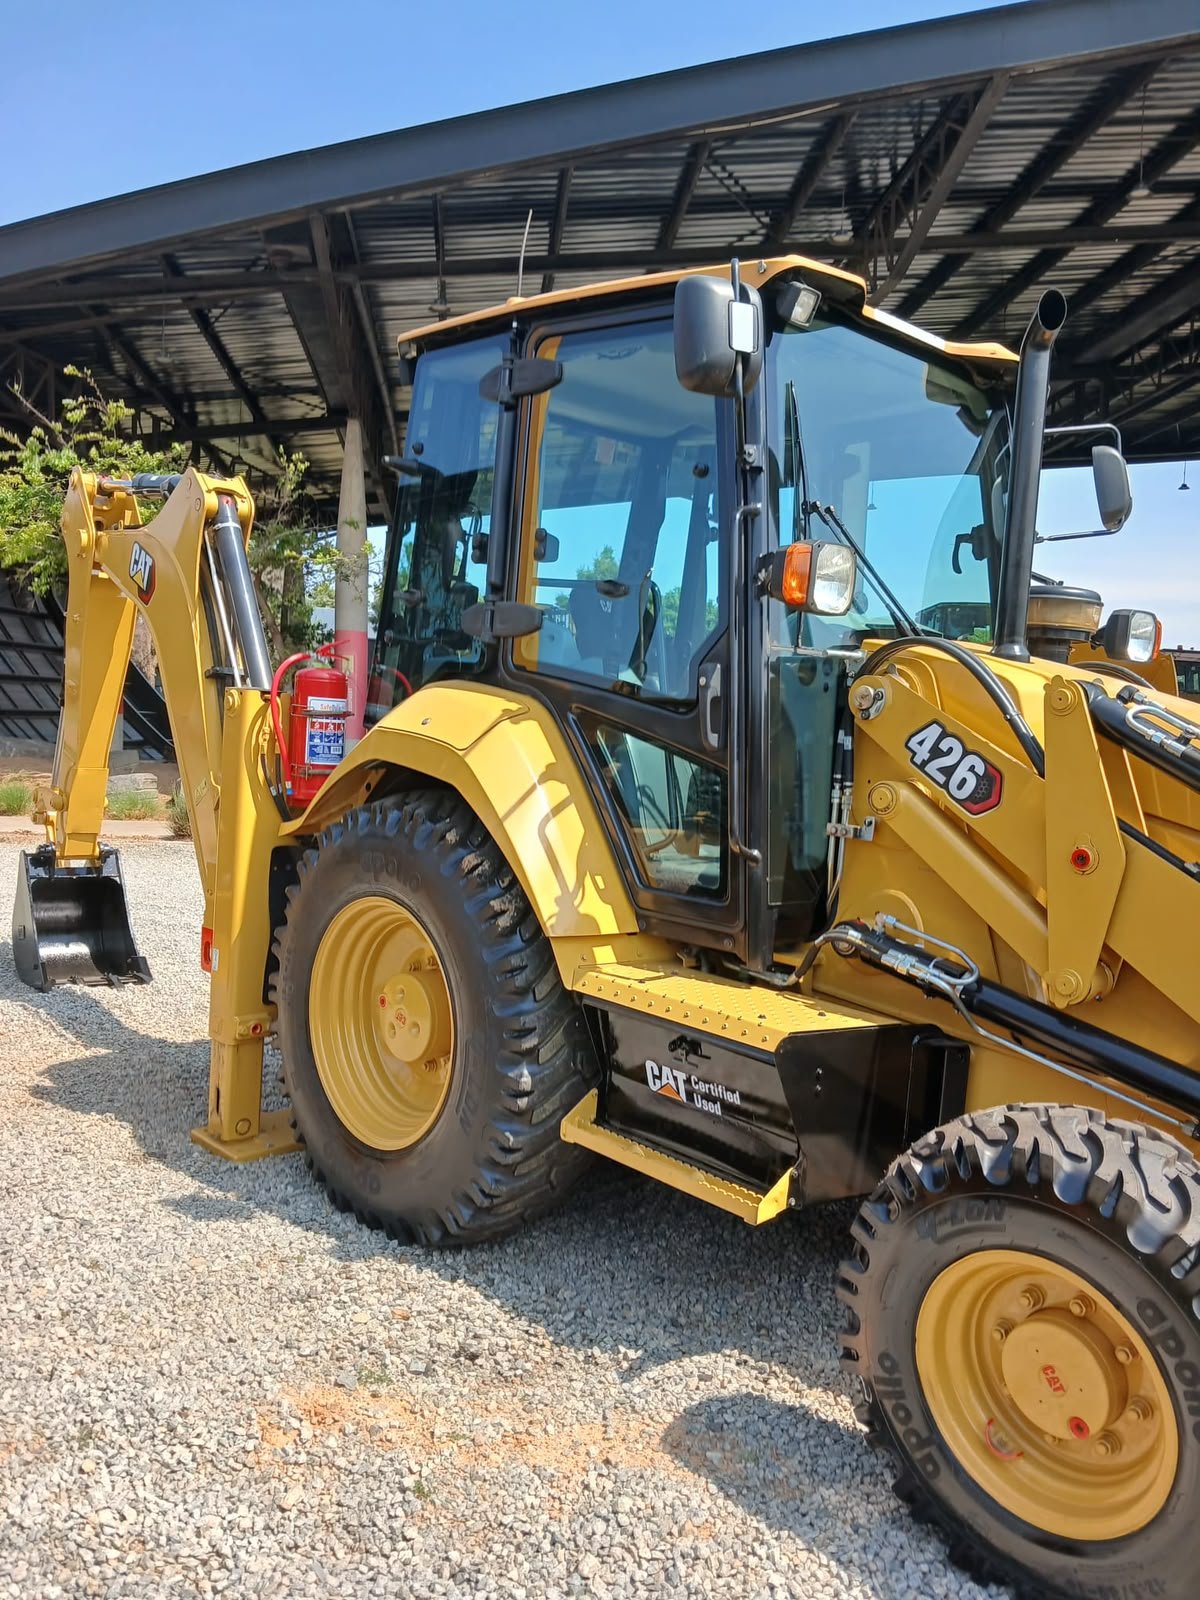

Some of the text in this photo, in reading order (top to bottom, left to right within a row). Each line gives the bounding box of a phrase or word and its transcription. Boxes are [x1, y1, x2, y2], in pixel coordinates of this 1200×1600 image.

[130, 542, 154, 592] CAT
[907, 723, 986, 800] 426
[645, 1060, 688, 1103] CAT
[691, 1075, 741, 1105] Certified
[693, 1093, 722, 1116] Used
[1042, 1365, 1066, 1393] CAT
[877, 1351, 942, 1481] apollo
